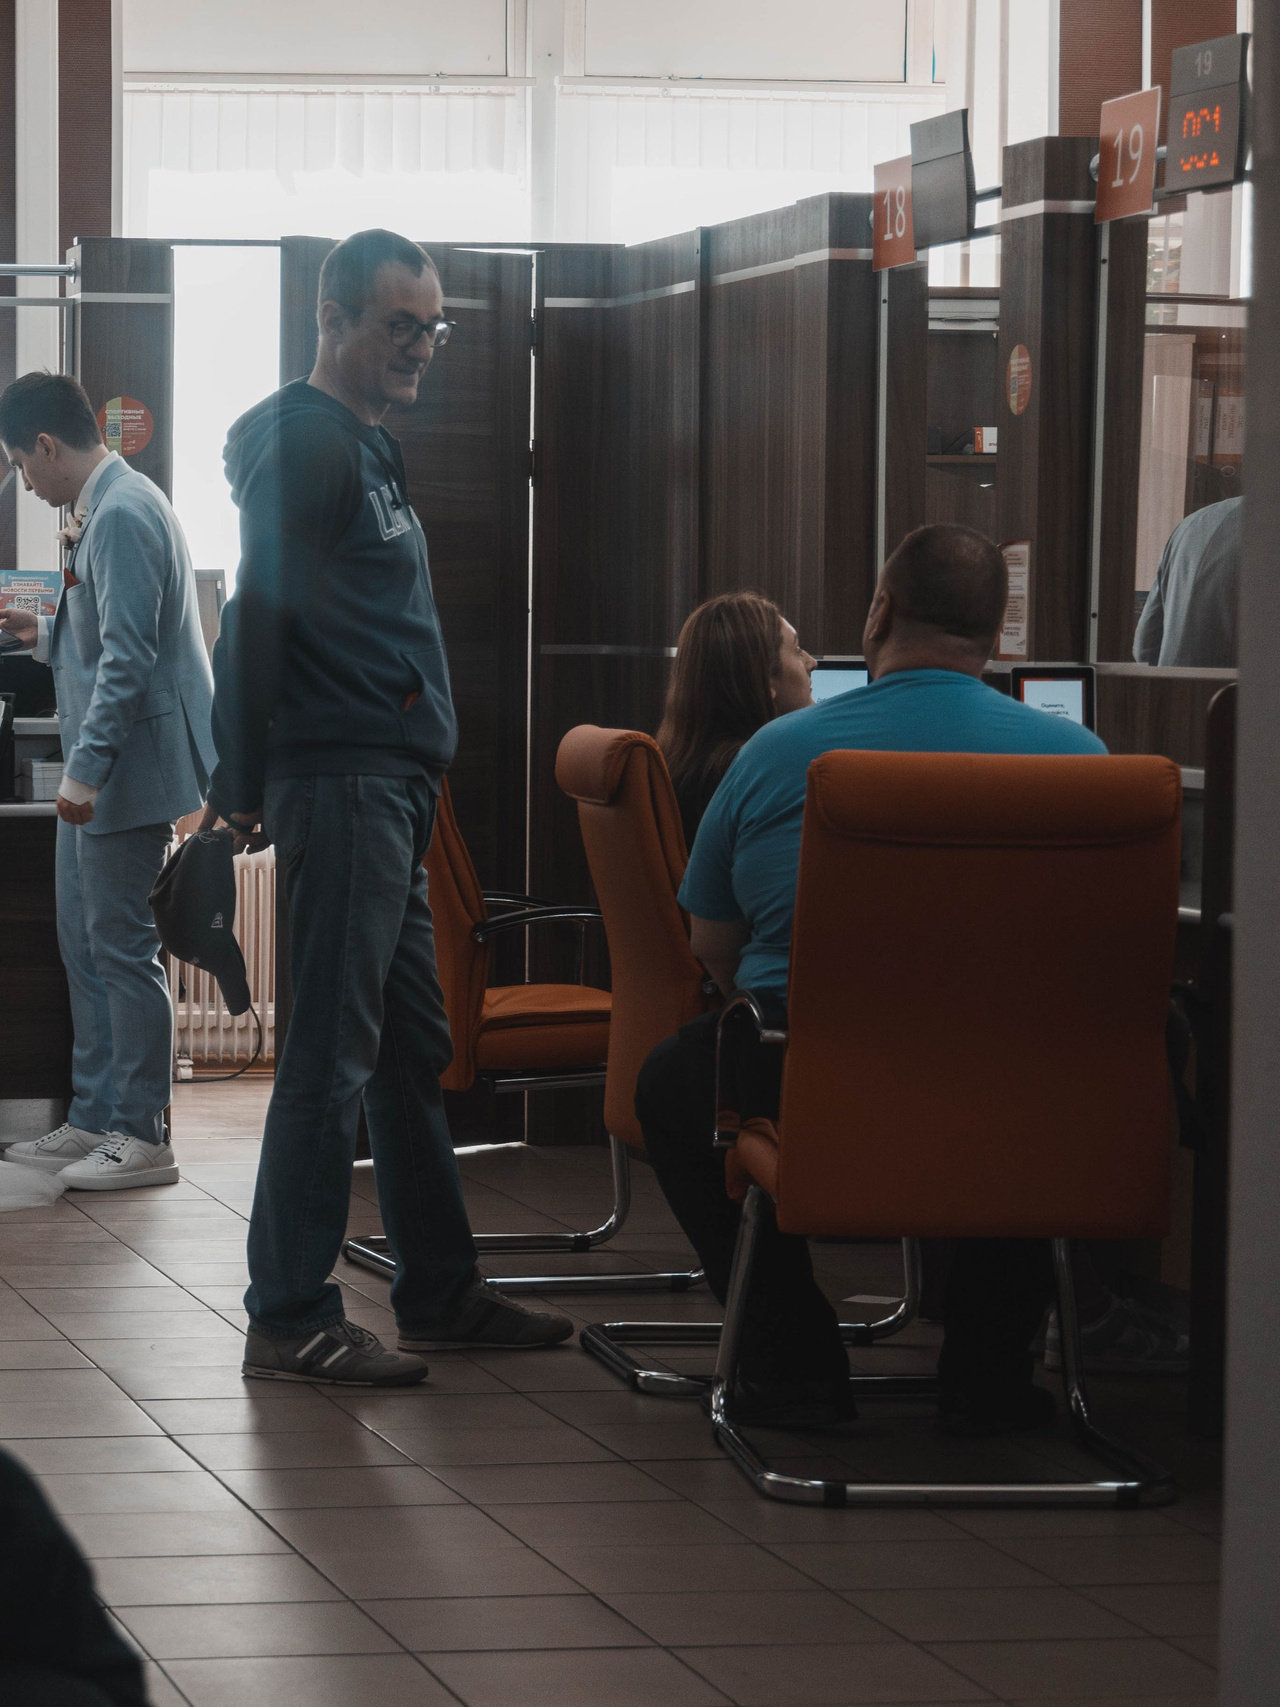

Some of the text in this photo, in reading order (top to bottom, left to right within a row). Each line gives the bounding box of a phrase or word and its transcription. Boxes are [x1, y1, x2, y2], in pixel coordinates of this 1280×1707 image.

[1194, 50, 1213, 78] 19
[1112, 123, 1144, 189] 19
[883, 185, 906, 241] 18
